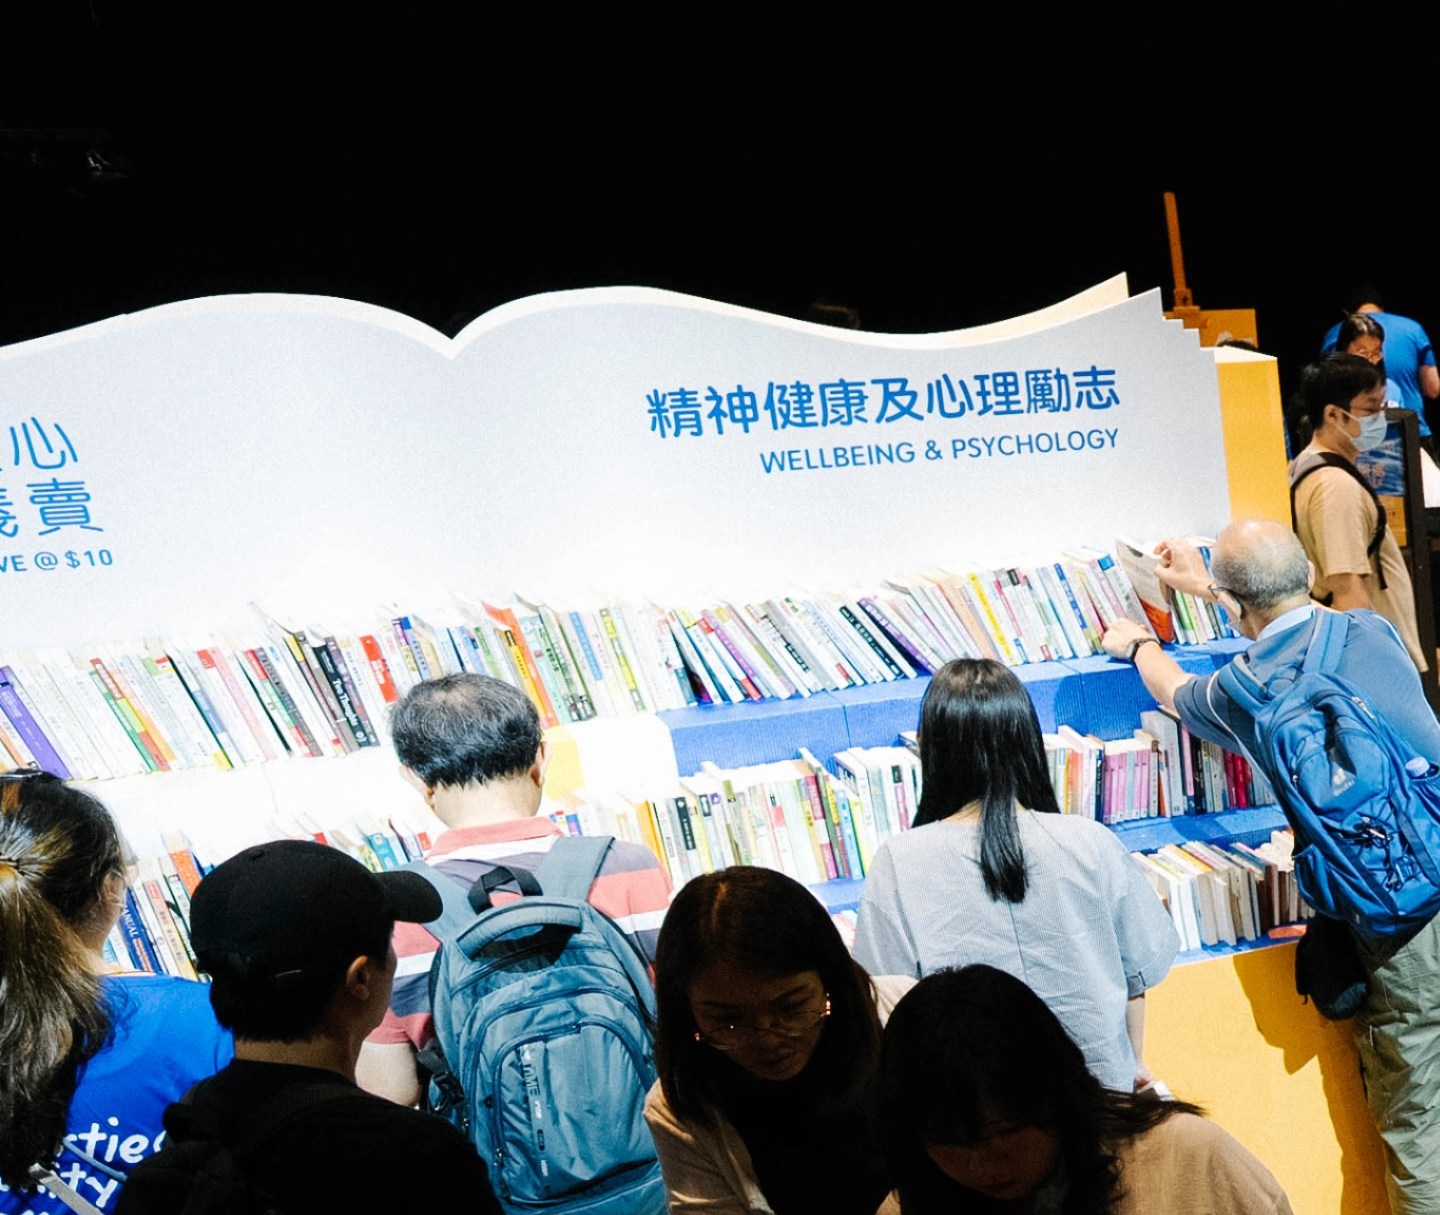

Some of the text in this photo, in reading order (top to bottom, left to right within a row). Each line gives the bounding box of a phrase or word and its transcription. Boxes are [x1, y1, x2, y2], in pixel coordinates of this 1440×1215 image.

[645, 364, 1121, 439] 精神健康及心理勵志
[760, 427, 1119, 474] WELLBEING & PSYCHOLOGY
[34, 548, 113, 571] @ $10
